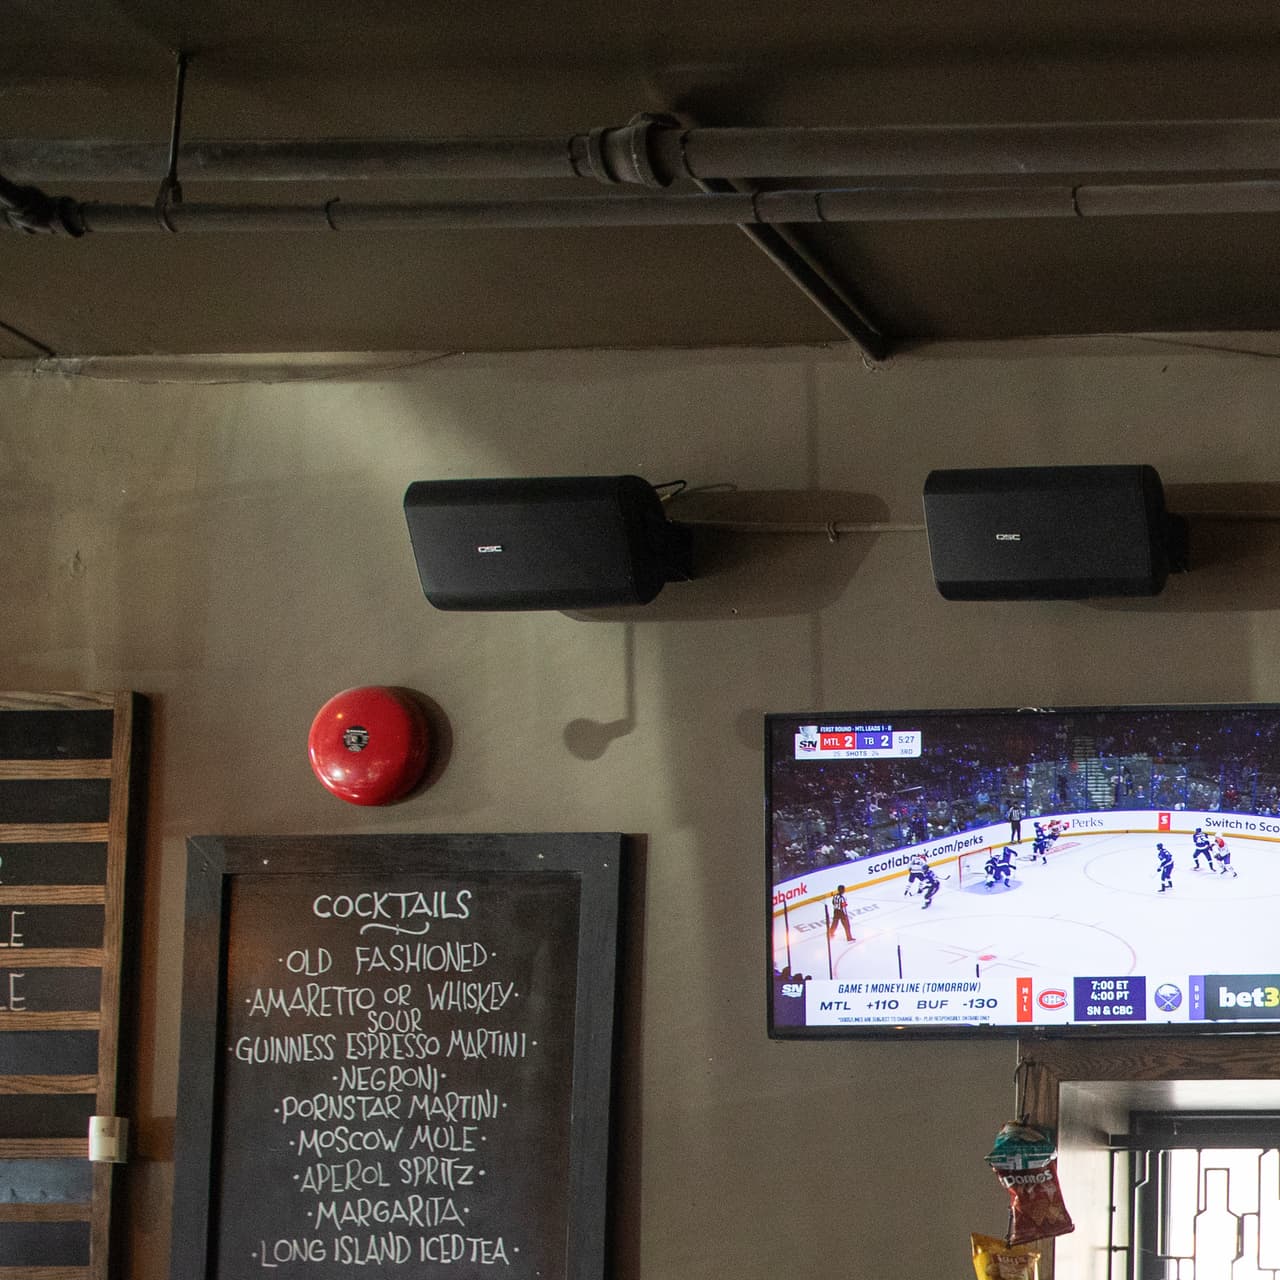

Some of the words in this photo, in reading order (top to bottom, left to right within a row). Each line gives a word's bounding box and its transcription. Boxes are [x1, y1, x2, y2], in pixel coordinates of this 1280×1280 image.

[800, 739, 818, 750] SN
[823, 737, 840, 746] MTL
[844, 735, 853, 748] 2
[864, 737, 875, 745] TB
[880, 735, 889, 747] 2
[898, 735, 915, 744] 5:27
[1072, 817, 1104, 829] Perks
[1205, 818, 1242, 831] Switch
[1246, 820, 1257, 831] to
[312, 889, 472, 919] COCKTAILS
[286, 948, 332, 976] OLD
[355, 941, 488, 976] FASHIONED
[249, 983, 376, 1017] AMARETTO
[384, 984, 412, 1006] OR
[427, 981, 514, 1014] WHISKEY
[782, 983, 803, 998] SN
[838, 983, 862, 994] GAME
[871, 982, 921, 993] MONEYLINE
[922, 981, 981, 994] (TOMORROW)
[1090, 991, 1114, 1001] 4:00
[1116, 990, 1130, 1001] PT
[1091, 980, 1114, 991] 7:00
[1116, 980, 1129, 991] ET
[820, 1001, 852, 1011] MTL
[866, 999, 899, 1010] +110
[917, 999, 949, 1010] BUF
[962, 998, 998, 1009] -130
[1087, 1005, 1101, 1016] SN
[1102, 1006, 1112, 1016] &
[1113, 1005, 1133, 1015] CBC
[367, 1007, 423, 1034] SOUR
[235, 1033, 337, 1065] GUINNESS
[346, 1031, 441, 1061] ESPRESSO
[446, 1027, 526, 1060] MARTINI
[339, 1064, 440, 1092] NEGRONI
[281, 1092, 402, 1125] PORNSTAR
[407, 1089, 499, 1122] MARTINI
[298, 1126, 404, 1158] MOSCOW
[409, 1125, 479, 1153] MULE
[300, 1158, 391, 1195] APEROL
[399, 1156, 475, 1192] SPRITZ
[315, 1194, 465, 1232] MARGARITA
[260, 1237, 327, 1268] LONG
[334, 1231, 412, 1266] ISLAND
[420, 1233, 465, 1264] ICED
[466, 1236, 511, 1266] TEA
